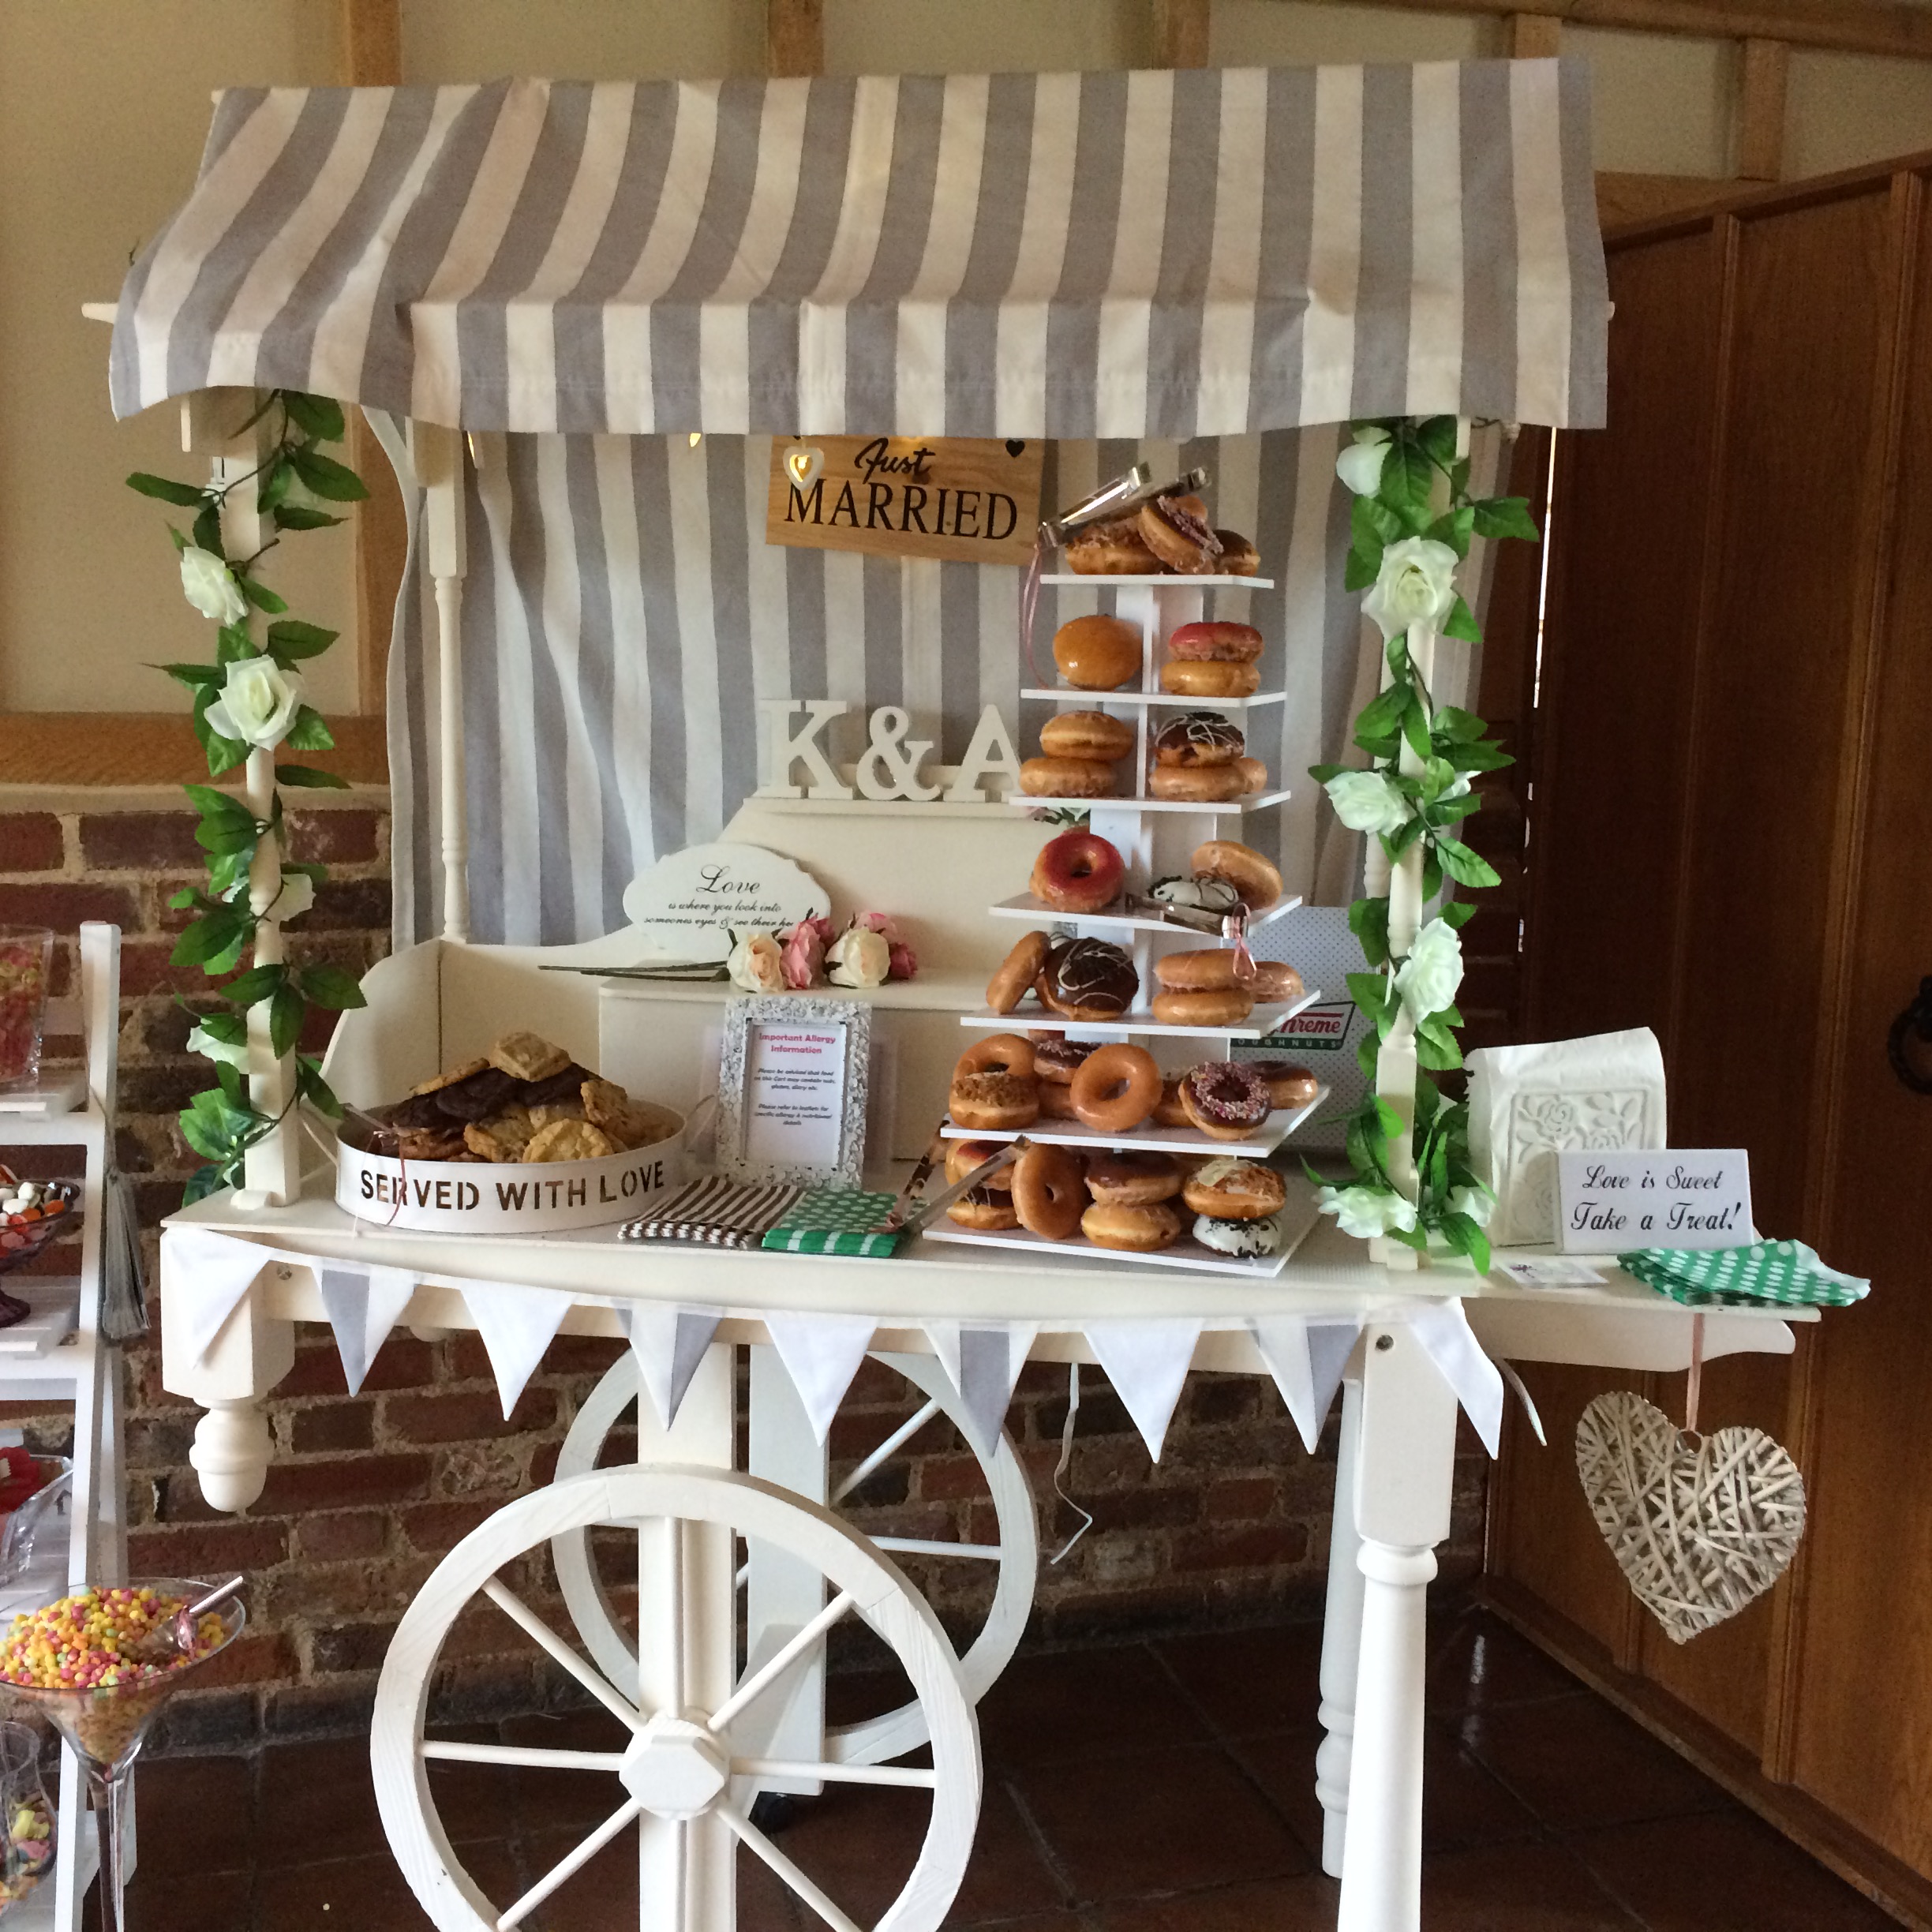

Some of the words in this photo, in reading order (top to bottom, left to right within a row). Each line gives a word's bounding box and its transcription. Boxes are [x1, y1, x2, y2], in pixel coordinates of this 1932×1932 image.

[855, 437, 936, 485] Just
[784, 477, 1018, 541] MARRIED
[752, 699, 853, 800] K
[856, 706, 942, 802] &
[943, 704, 1022, 803] A
[695, 864, 761, 894] Love
[679, 899, 710, 911] where
[711, 903, 732, 918] you
[735, 900, 758, 912] look
[760, 901, 782, 912] into
[695, 918, 717, 929] eyes
[720, 915, 733, 930] &
[751, 915, 777, 927] their
[758, 1032, 803, 1042] Important
[805, 1034, 836, 1044] Allergy
[771, 1045, 822, 1054] Information
[1237, 1038, 1337, 1048] OUGHNUTS
[361, 1170, 480, 1211] SERVED
[496, 1178, 586, 1211] WITH
[599, 1160, 664, 1202] LOVE
[1582, 1165, 1631, 1189] Love
[1641, 1170, 1655, 1189] is
[1666, 1166, 1724, 1190] Sweet
[1571, 1201, 1627, 1231] Take
[1640, 1214, 1656, 1231] a
[1666, 1201, 1743, 1231] Treat!
